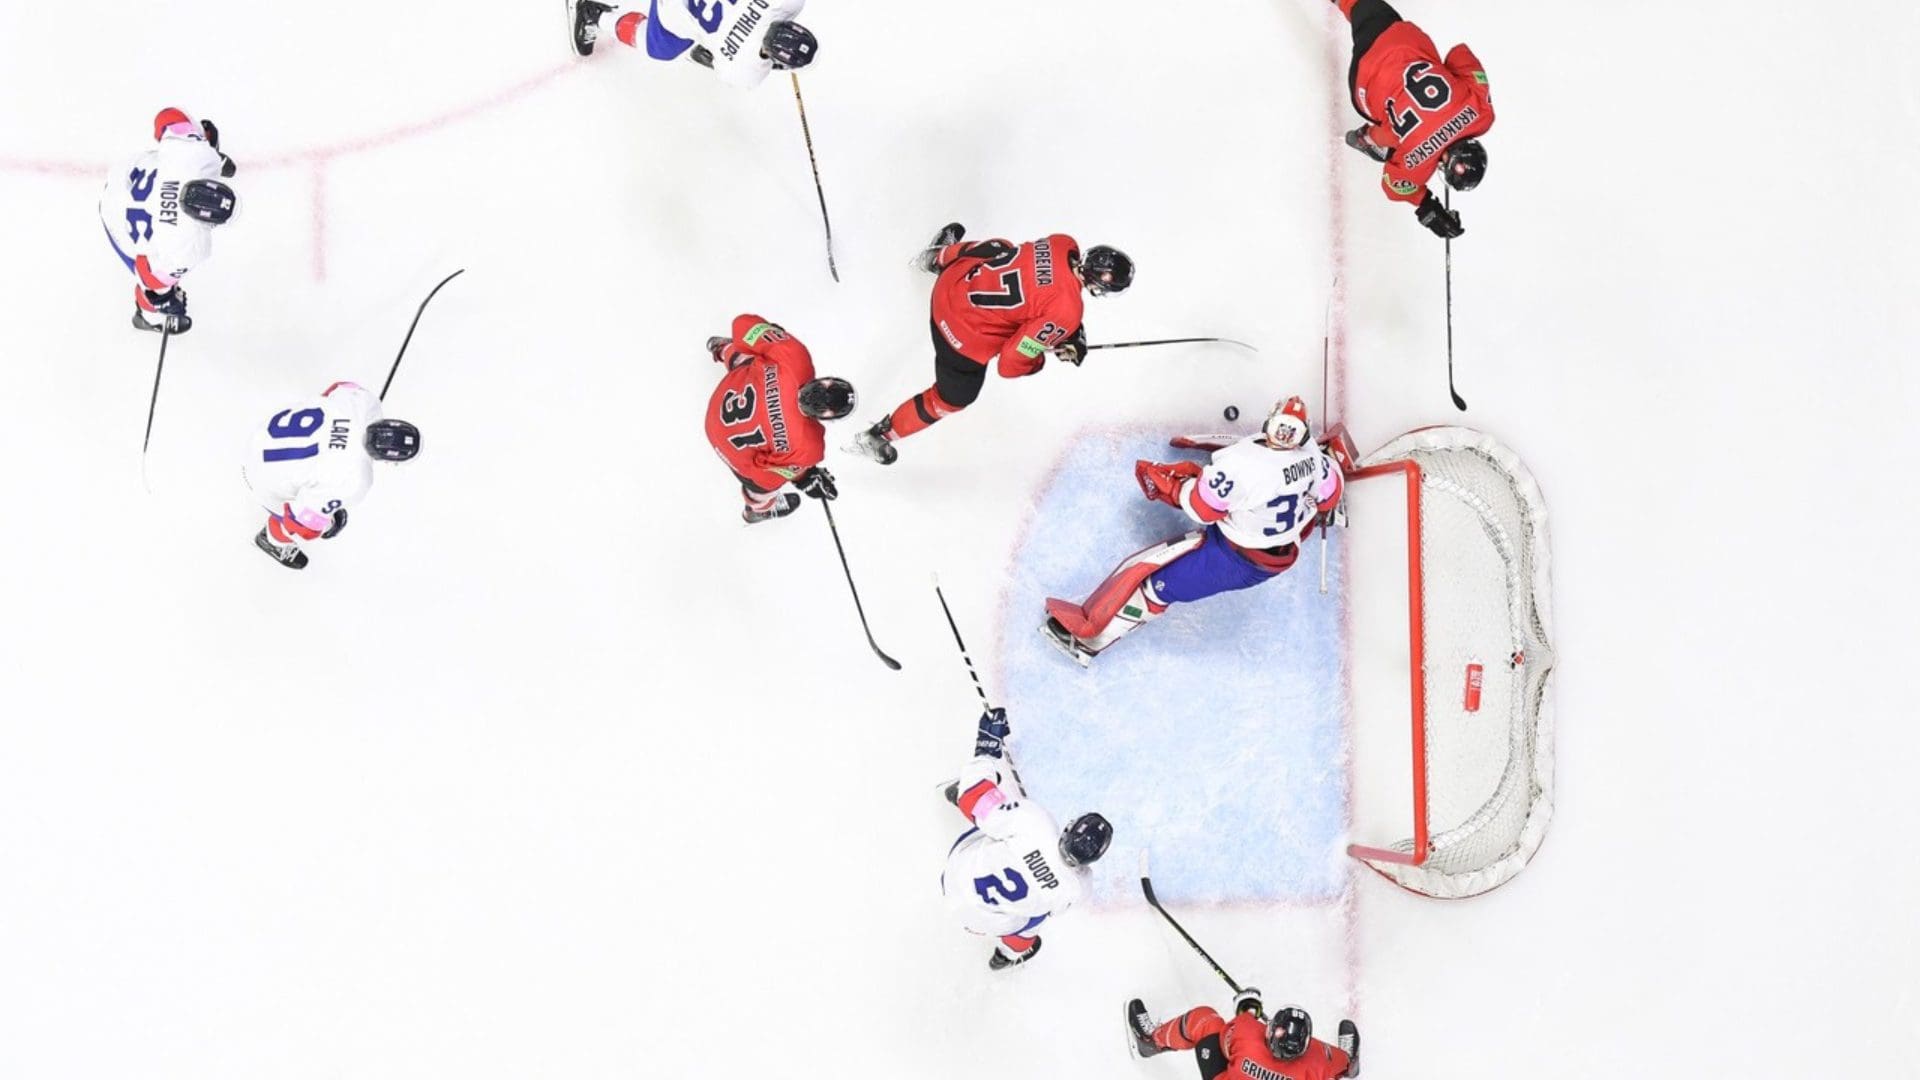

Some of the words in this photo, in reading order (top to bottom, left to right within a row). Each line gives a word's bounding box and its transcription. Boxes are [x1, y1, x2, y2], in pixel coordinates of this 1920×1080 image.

[688, 0, 741, 34] 3
[1385, 61, 1452, 140] 97
[1404, 107, 1478, 170] KRAKAUSKAS
[159, 180, 179, 226] MOSEY
[1036, 321, 1067, 347] 27
[263, 407, 325, 463] 91
[328, 419, 350, 450] LAKE
[720, 382, 767, 449] 31
[1209, 471, 1235, 499] 33
[974, 867, 1029, 906] 2
[1023, 849, 1059, 890] RUOPP
[1241, 1058, 1293, 1080] GRINI
